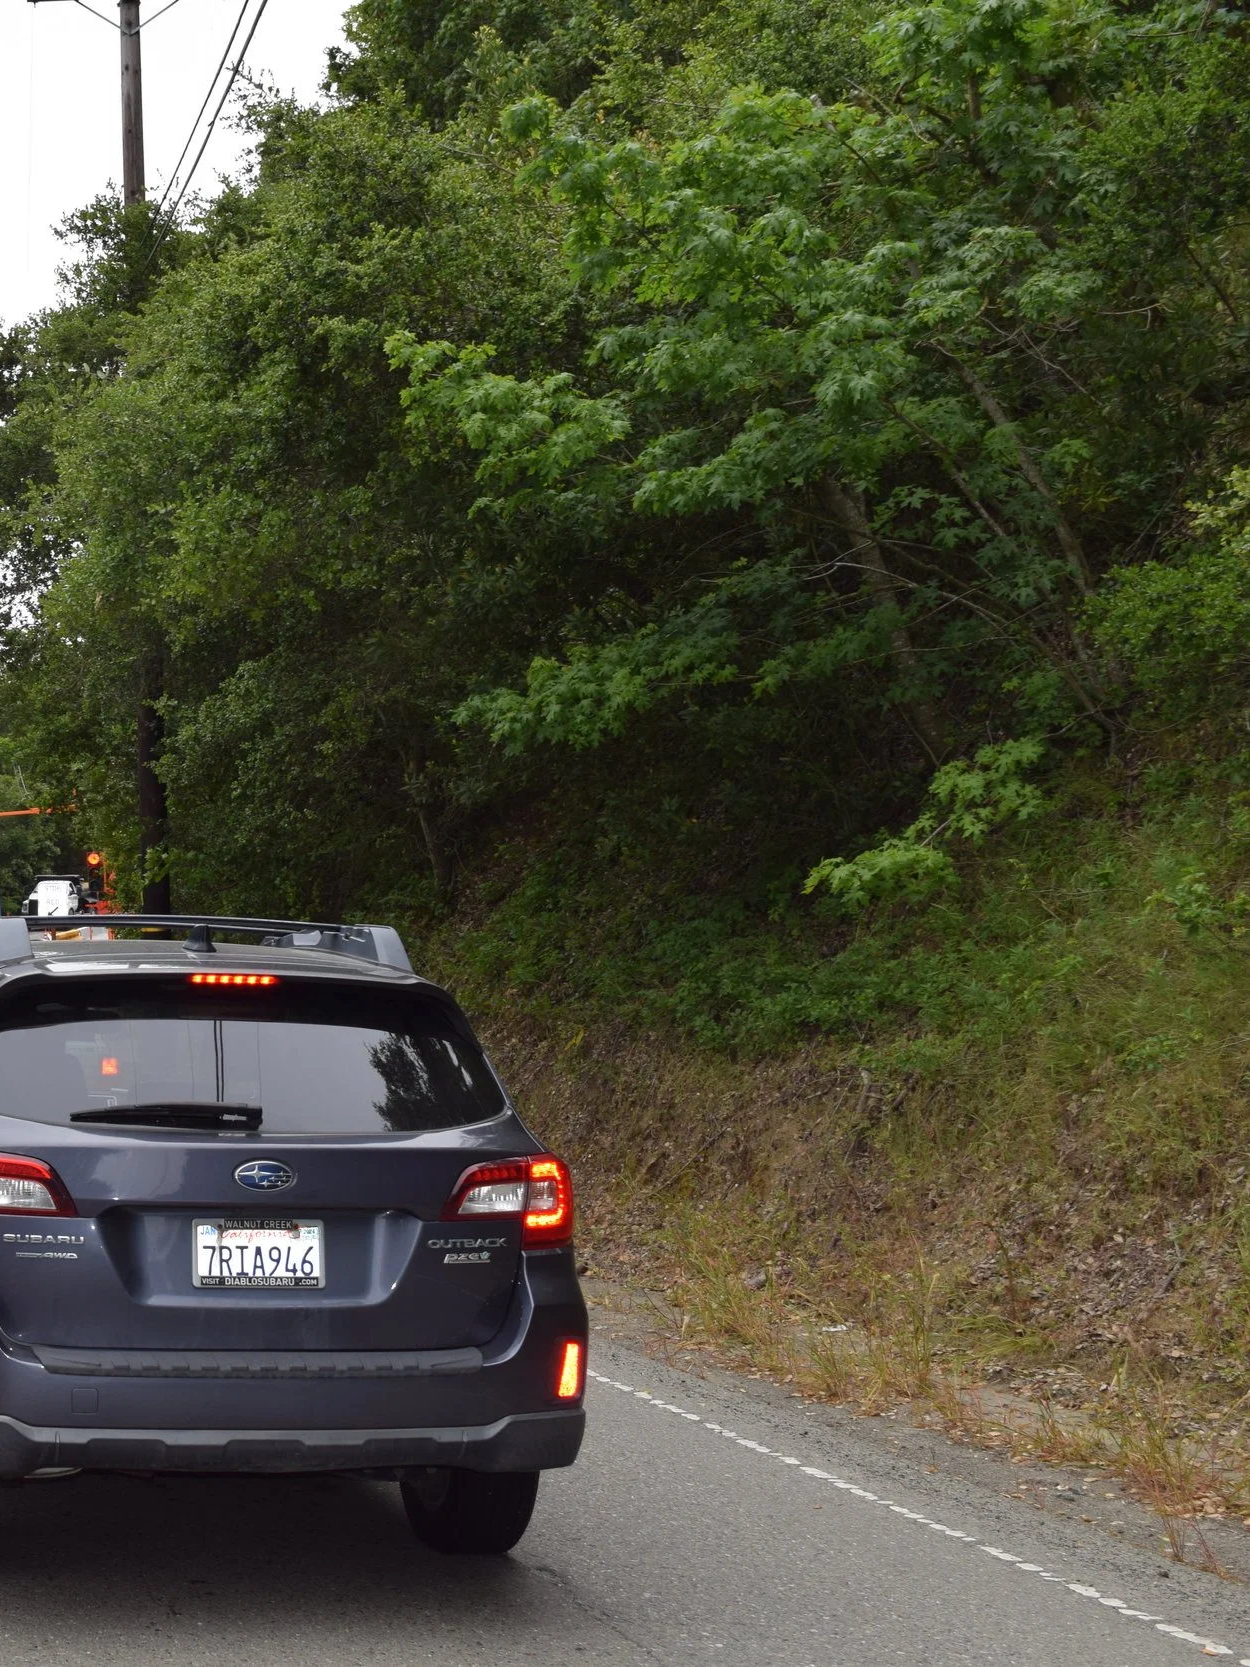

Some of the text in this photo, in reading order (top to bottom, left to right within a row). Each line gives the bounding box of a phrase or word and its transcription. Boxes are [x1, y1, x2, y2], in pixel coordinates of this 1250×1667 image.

[224, 1220, 292, 1229] WALNUT CREEK
[200, 1226, 216, 1236] JAN
[3, 1233, 85, 1245] SUBARU
[427, 1238, 508, 1248] OUTBACK
[202, 1245, 314, 1277] 7RIA946
[224, 1277, 296, 1286] DIABLOSUBARU
